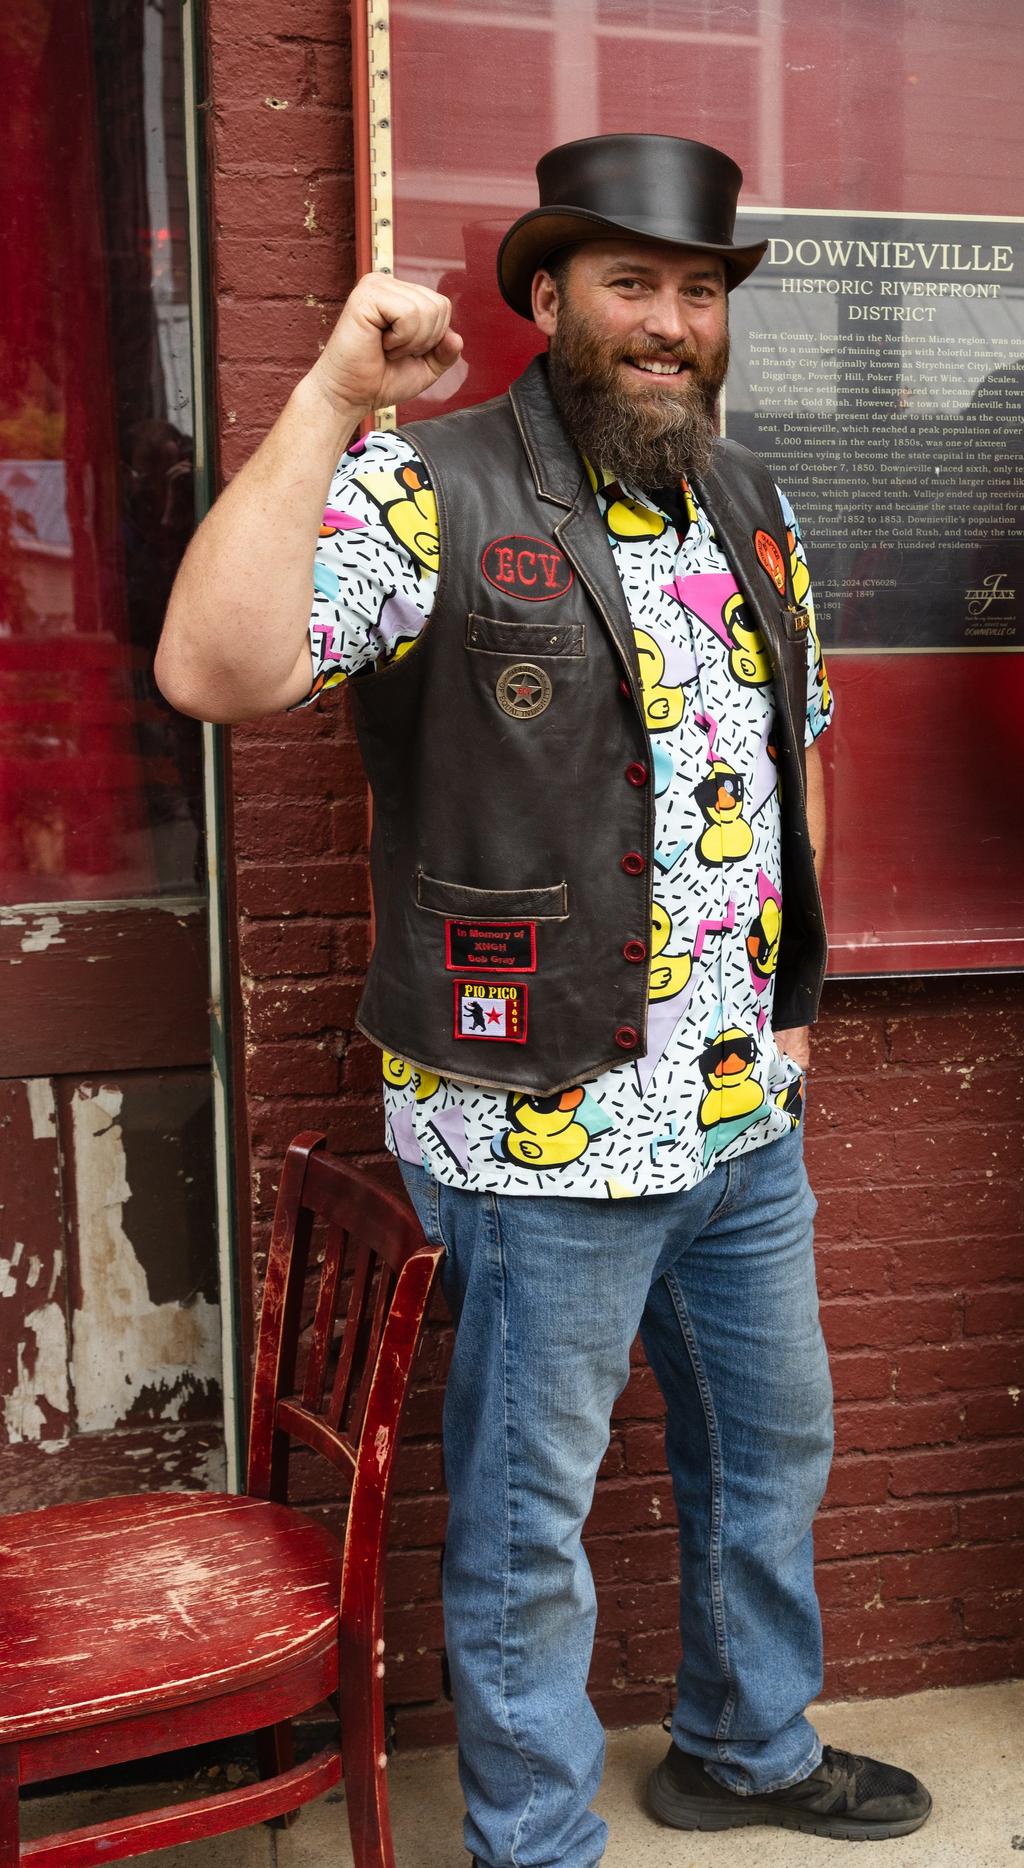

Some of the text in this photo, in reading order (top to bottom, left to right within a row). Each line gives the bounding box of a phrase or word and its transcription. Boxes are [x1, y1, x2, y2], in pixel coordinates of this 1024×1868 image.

[768, 239, 1014, 272] DOWNIEVILLE
[781, 279, 1000, 298] HISTORIC RIVERFRONT
[848, 306, 936, 322] DISTRICT
[749, 332, 954, 343] Sierra County, located Northern Mines
[750, 344, 970, 357] home number mining camps colorful
[762, 358, 796, 368] Brandy
[799, 359, 817, 369] City
[915, 361, 964, 371] Strychnine
[808, 372, 1018, 382] Poverty Hill, Poker Scales.
[749, 384, 774, 394] Many
[788, 384, 813, 392] these
[816, 384, 869, 393] settlements
[942, 386, 974, 394] became
[978, 387, 1001, 397] ghost
[759, 396, 780, 405] after
[801, 397, 822, 405] Gold
[855, 398, 896, 407] However,
[952, 399, 1003, 408] Downieville
[754, 410, 793, 418] survived
[796, 410, 814, 419] into
[835, 412, 868, 421] present
[995, 414, 1024, 423] county
[783, 423, 839, 432] Downieville,
[842, 424, 868, 432] which
[872, 424, 907, 432] reached
[918, 425, 939, 435] peak
[942, 425, 990, 436] population
[775, 436, 1006, 447] 5,000 miners early 1850s, sixteen
[816, 450, 840, 460] vying
[854, 450, 888, 458] become
[933, 451, 962, 460] capital
[801, 462, 990, 472] October 1850. Downieville sixth,
[777, 475, 808, 483] behind
[812, 475, 868, 485] Sacramento,
[890, 476, 916, 484] ahead
[931, 476, 955, 484] much
[958, 477, 984, 487] larger
[987, 477, 1010, 485] cities
[822, 489, 848, 497] which
[852, 489, 880, 499] placed
[884, 489, 909, 497] tenth.
[913, 489, 943, 499] Vallejo
[946, 489, 972, 497] ended
[835, 502, 872, 511] majority
[895, 502, 928, 510] became
[973, 502, 1002, 512] capital
[907, 515, 964, 523] Downieville's
[968, 515, 1015, 525] population
[916, 528, 941, 536] Rush,
[964, 528, 987, 537] today
[495, 547, 560, 588] ECV
[464, 985, 517, 999] PIO PICO
